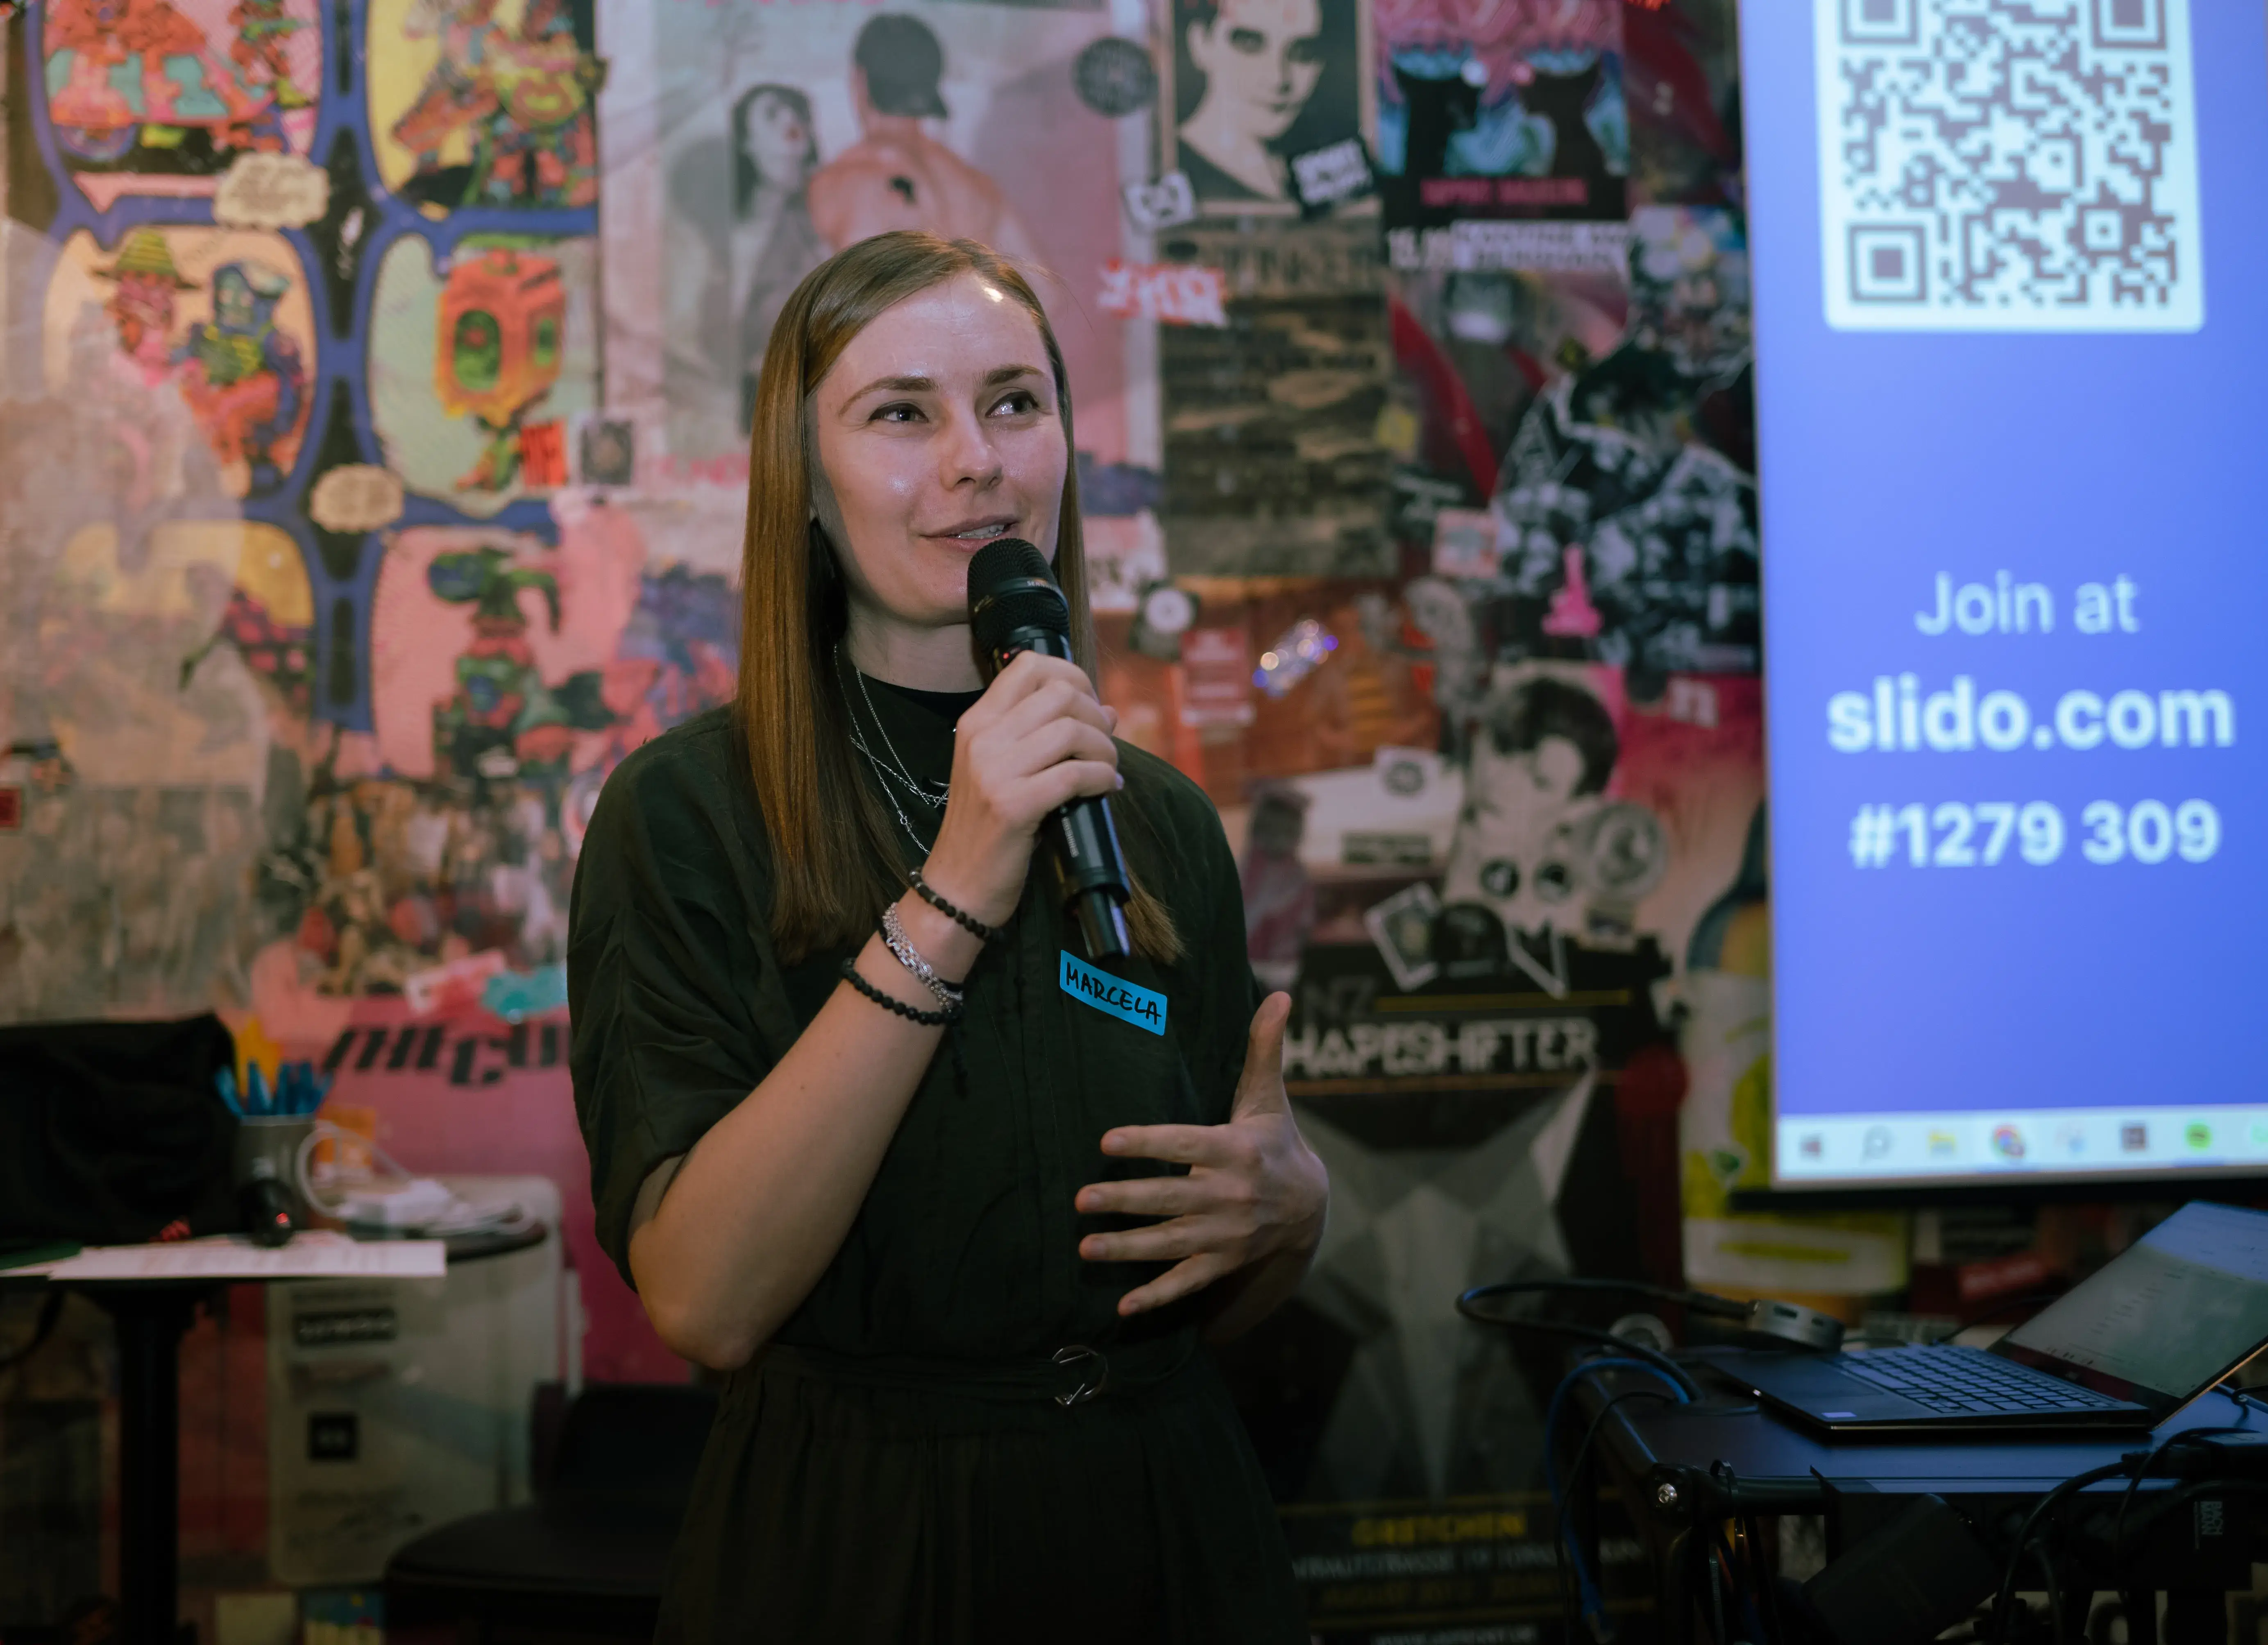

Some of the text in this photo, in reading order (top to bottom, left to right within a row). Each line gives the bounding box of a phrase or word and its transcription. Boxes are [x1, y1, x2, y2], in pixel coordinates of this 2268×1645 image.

[1915, 570, 2140, 635] Join at
[1827, 672, 2235, 752] slido.com
[1849, 798, 2222, 868] #1279 309
[1066, 961, 1162, 1025] MARCELA
[1284, 1017, 1599, 1076] HAPESHIFTER
